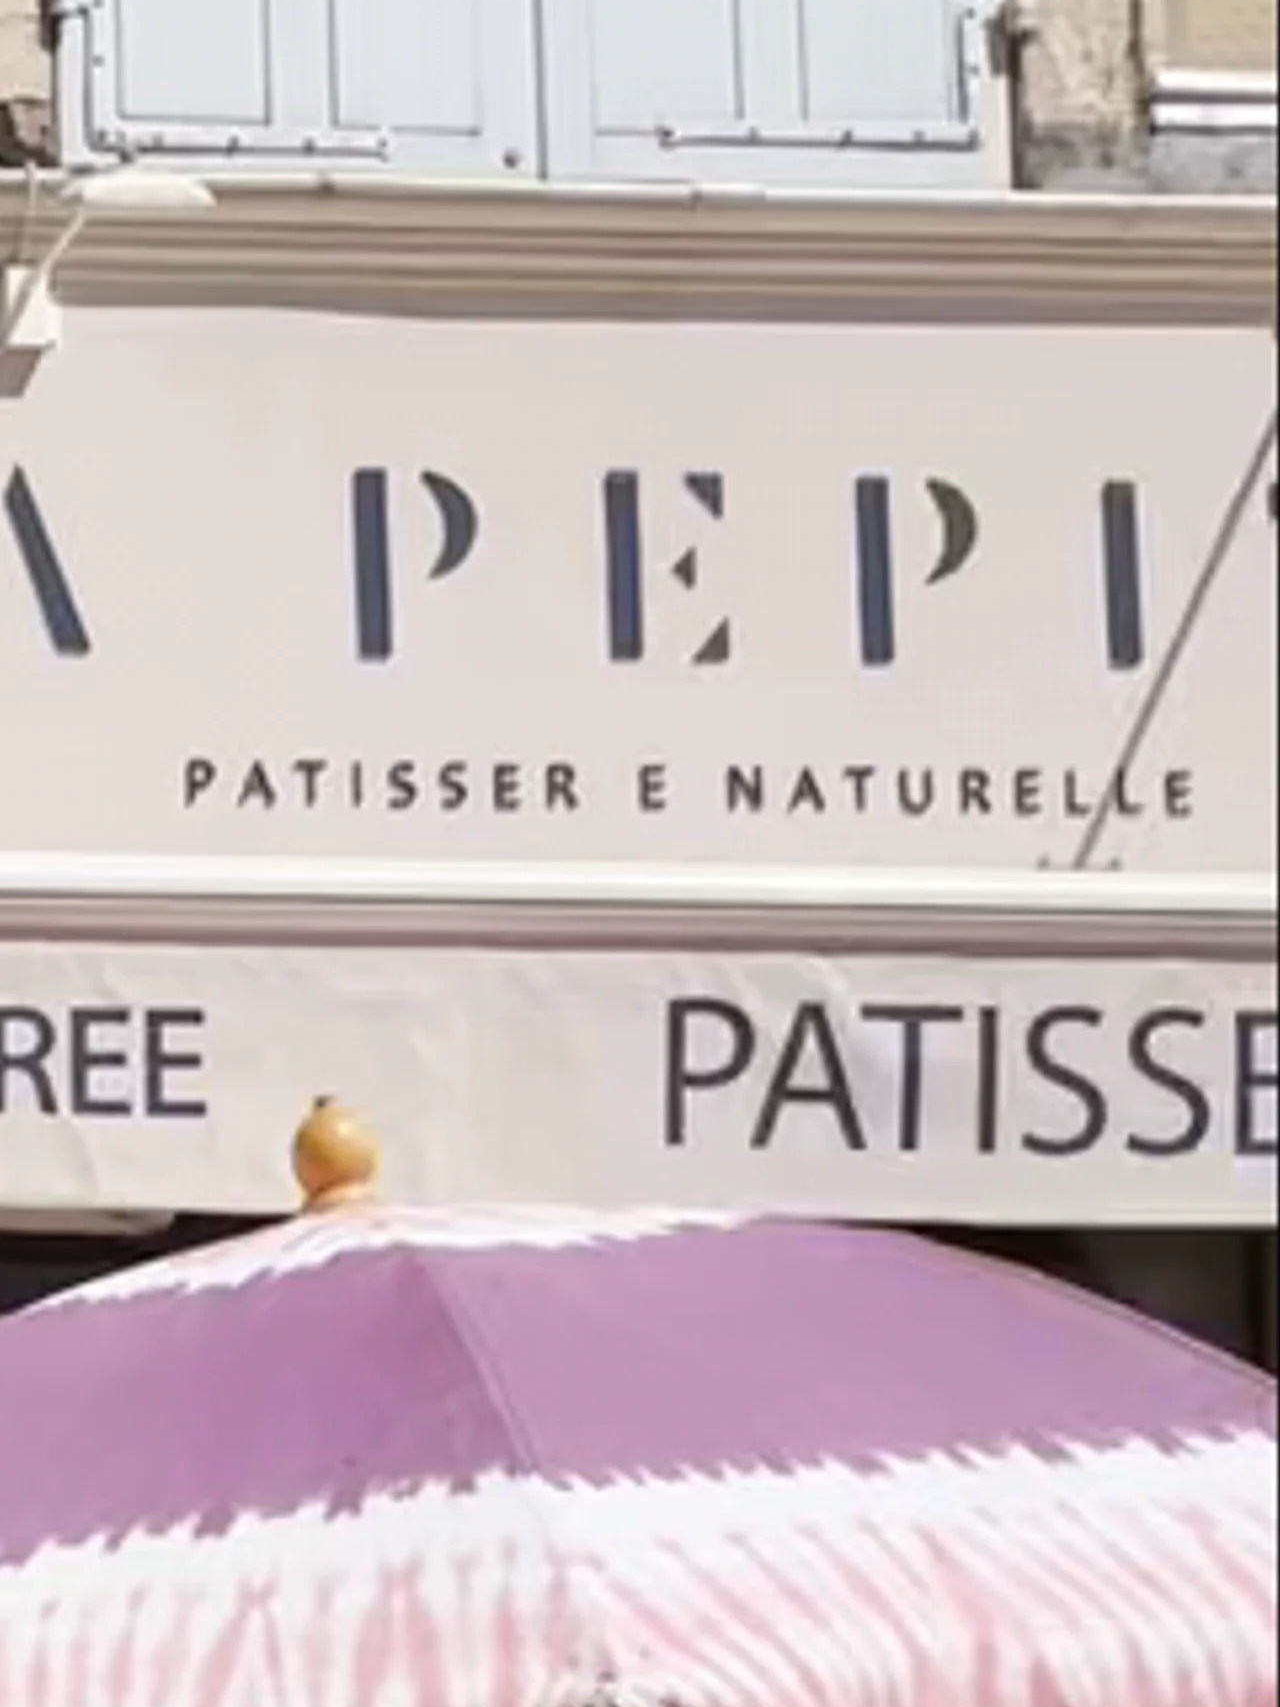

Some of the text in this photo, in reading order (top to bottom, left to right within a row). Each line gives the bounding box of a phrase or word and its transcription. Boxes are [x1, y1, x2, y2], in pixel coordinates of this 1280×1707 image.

[352, 468, 1278, 670] PEPI
[725, 764, 1191, 818] NATURELLE
[665, 997, 1278, 1157] PATISSE
